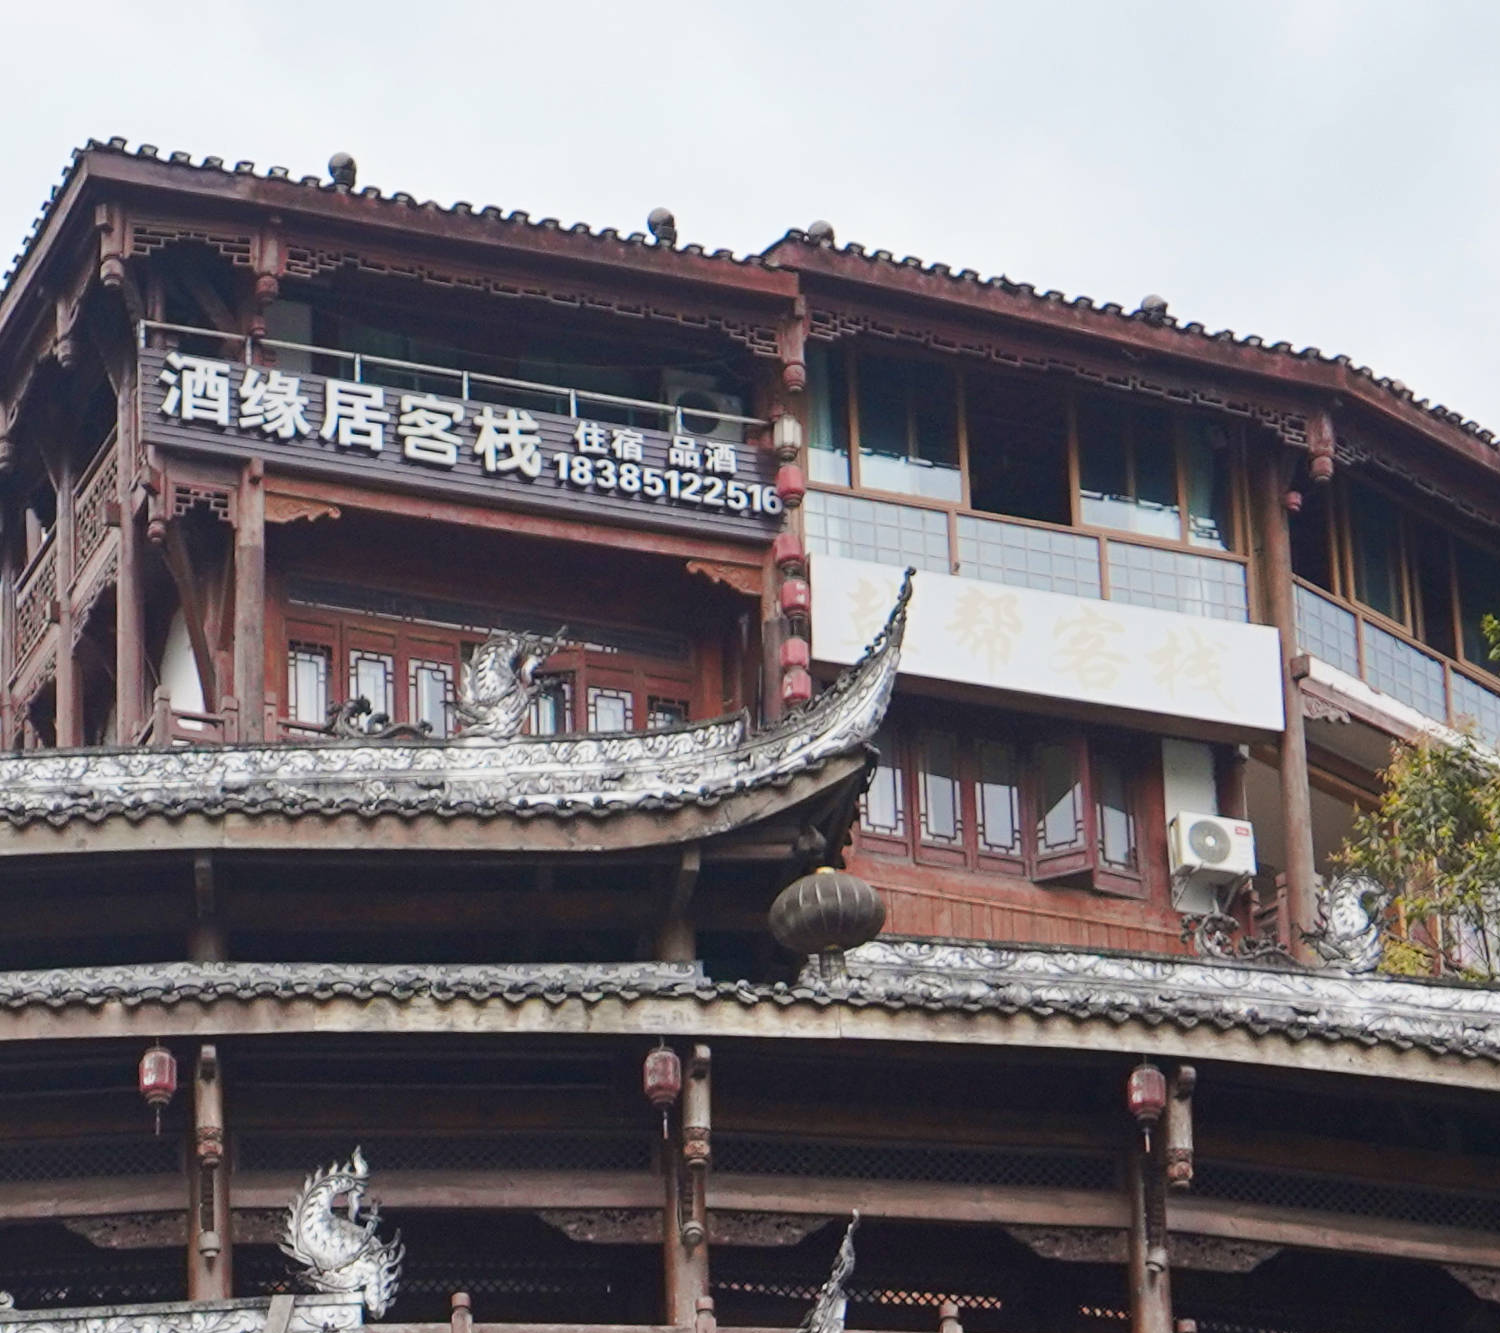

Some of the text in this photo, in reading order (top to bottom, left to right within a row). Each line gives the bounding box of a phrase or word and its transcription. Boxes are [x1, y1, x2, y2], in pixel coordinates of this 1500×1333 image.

[160, 351, 542, 478] 酒缘居客栈
[574, 420, 738, 474] 住宿 品酒
[553, 452, 783, 514] 18385122516
